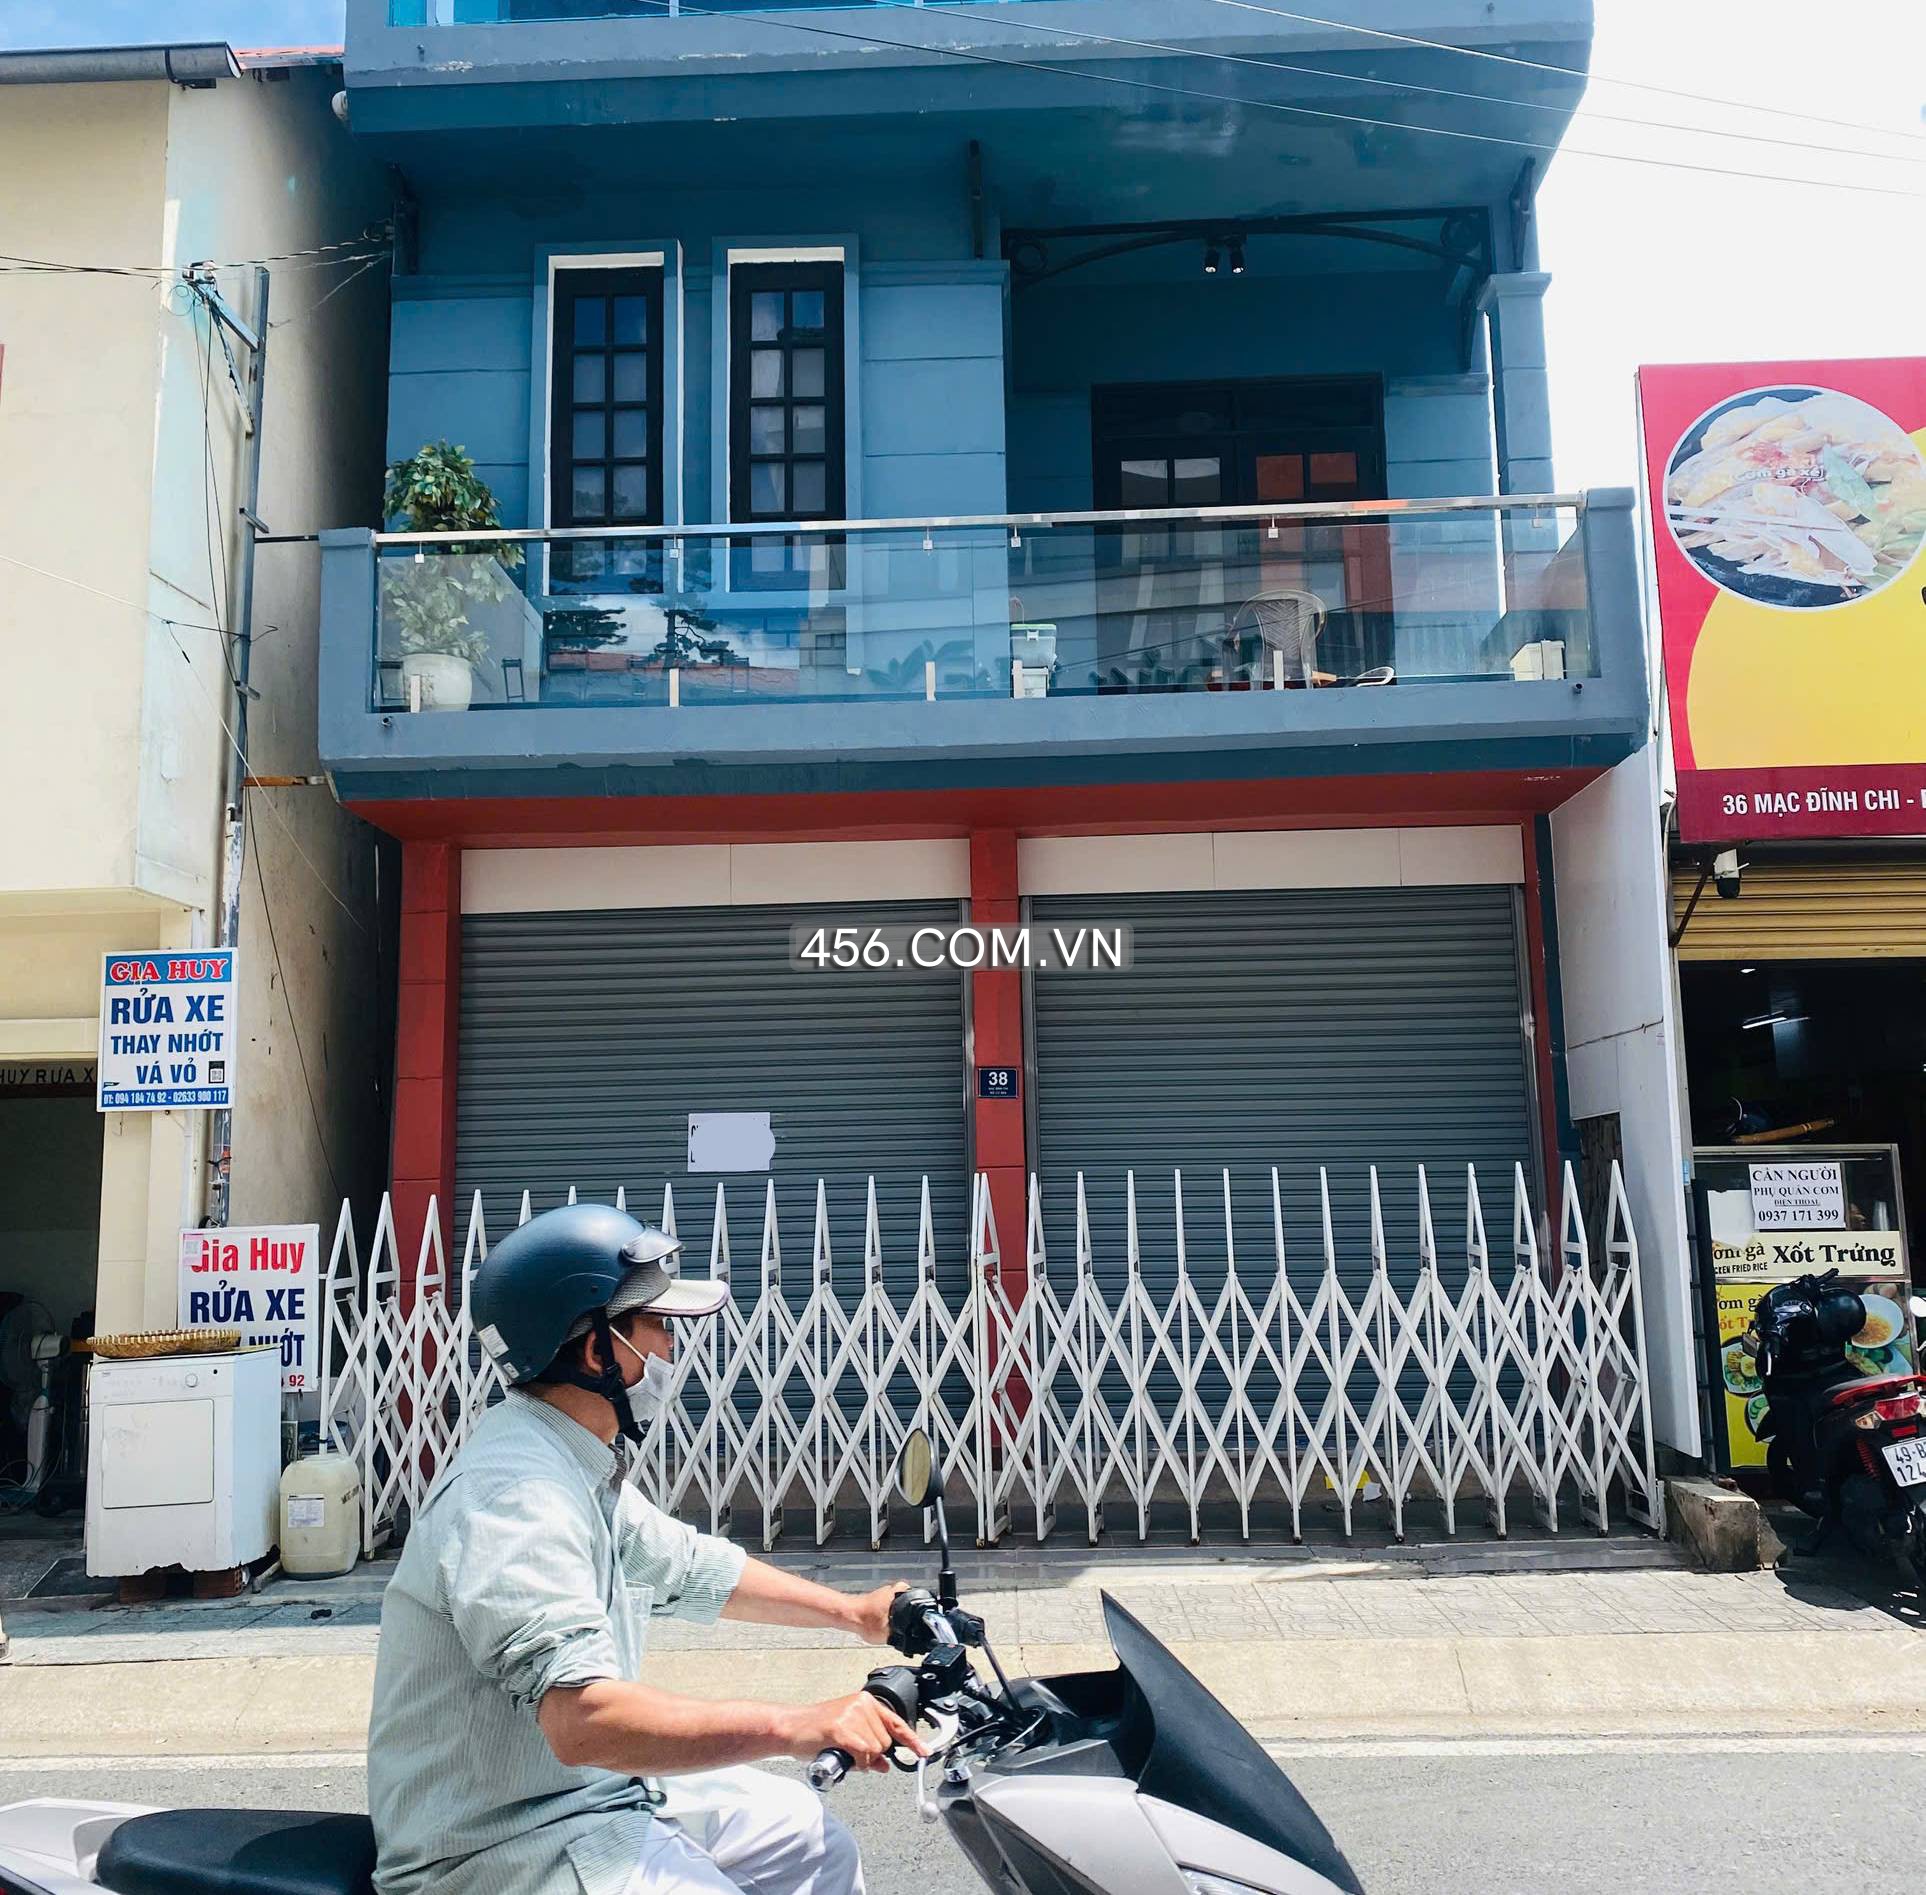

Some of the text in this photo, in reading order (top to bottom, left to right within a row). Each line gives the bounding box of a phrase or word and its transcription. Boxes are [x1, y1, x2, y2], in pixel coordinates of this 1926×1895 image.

[1722, 794, 1748, 815] 36
[1754, 792, 1800, 818] MẠC
[1805, 787, 1858, 812] ĐĨNH
[1864, 789, 1900, 811] CHI
[110, 959, 227, 983] GIA HUY
[111, 987, 225, 1025] RỬA XE
[111, 1029, 224, 1054] THAY NHỚT
[136, 1057, 197, 1085] VÁ VỎ
[988, 1071, 1008, 1086] 38
[157, 1091, 167, 1103] 92
[213, 1090, 227, 1102] 117
[1787, 1165, 1837, 1181] NGƯỜI
[1754, 1186, 1776, 1197] PHỤ
[1813, 1186, 1839, 1195] CƠM
[1758, 1209, 1839, 1222] 0937 171 399
[250, 1237, 305, 1273] Huy
[1745, 1242, 1766, 1262] gà
[1773, 1241, 1815, 1264] Xốt
[1819, 1242, 1896, 1267] Trứng
[1732, 1263, 1752, 1273] FRIED
[1753, 1262, 1768, 1272] RICE
[190, 1279, 305, 1323] RỬA XE
[289, 1374, 305, 1387] 92
